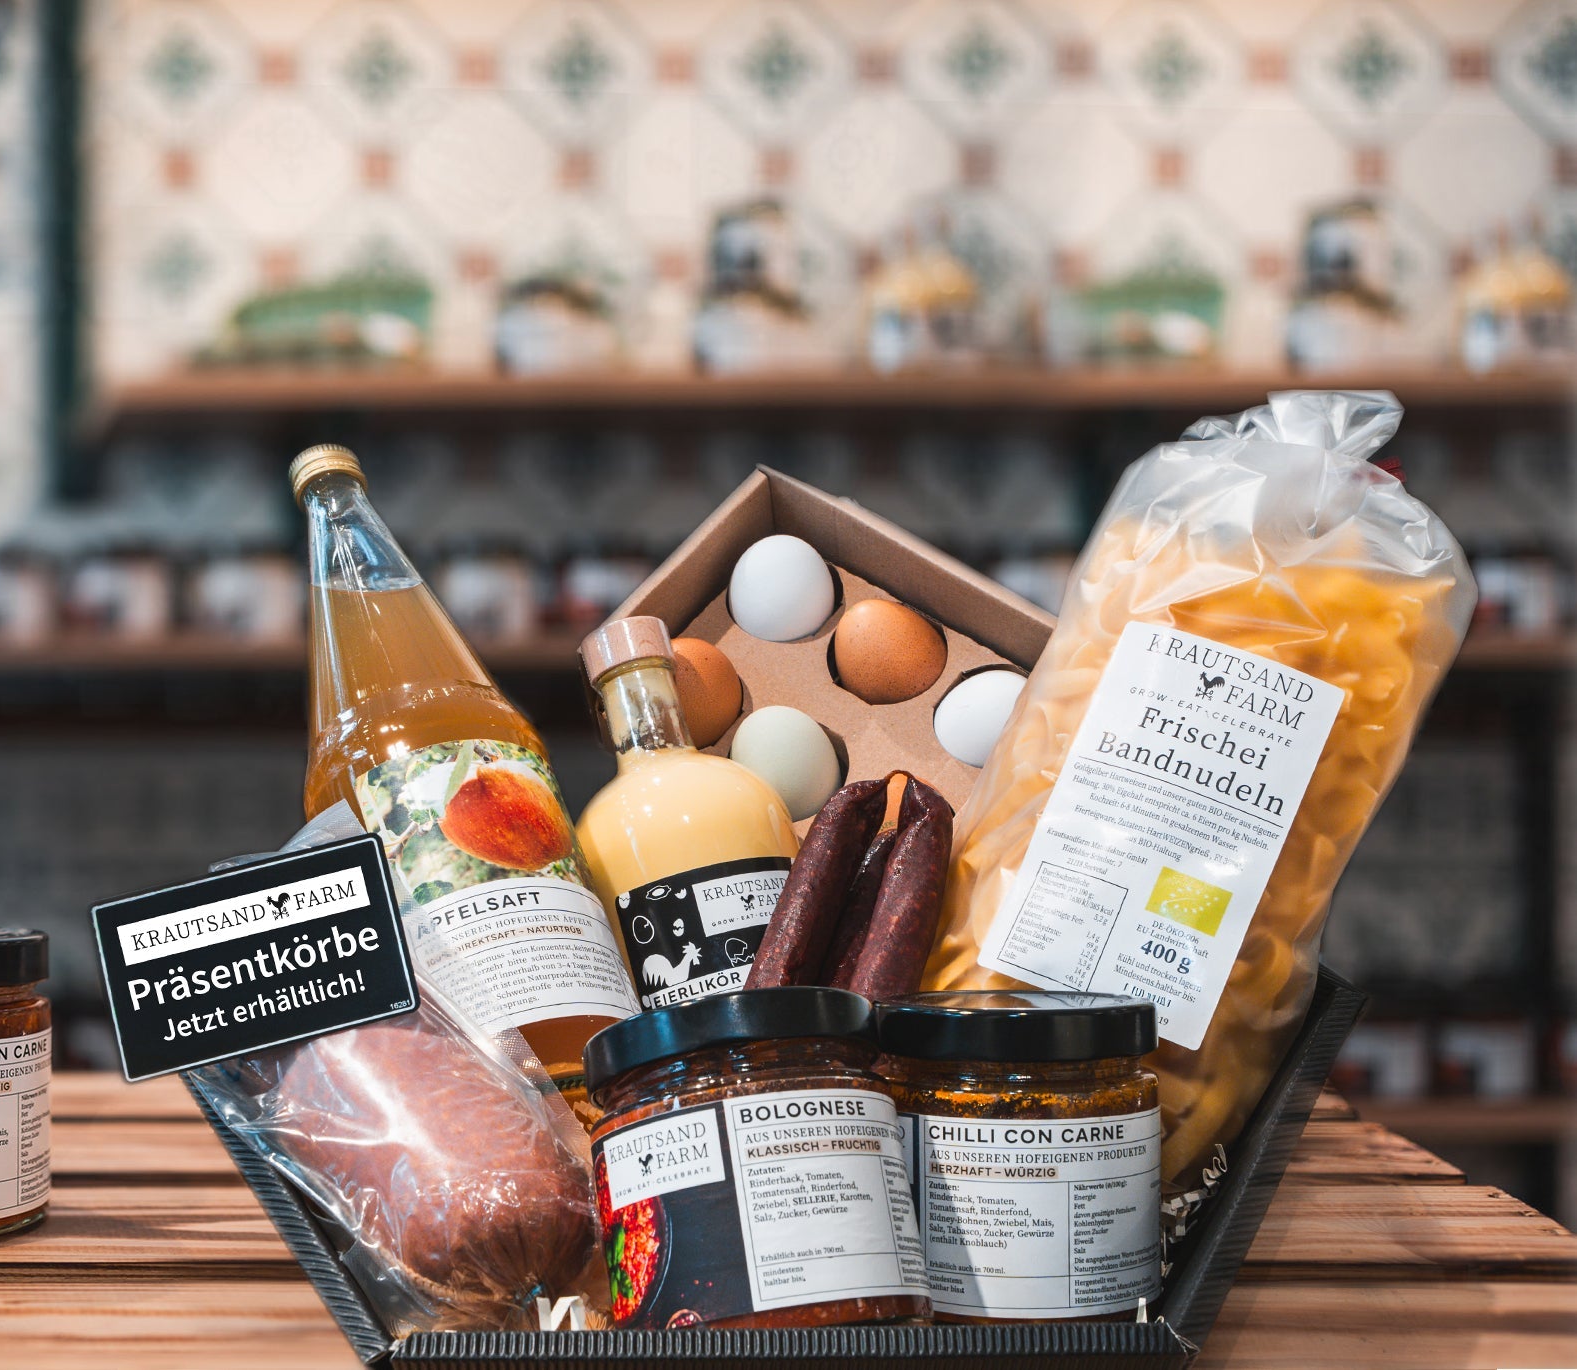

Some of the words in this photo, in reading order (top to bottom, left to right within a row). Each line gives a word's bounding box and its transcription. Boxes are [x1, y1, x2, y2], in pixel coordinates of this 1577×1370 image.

[1147, 634, 1313, 703] KRAUTSAND
[1223, 684, 1305, 730] FARM
[1177, 700, 1202, 713] EAT
[1212, 711, 1293, 748] CELEBRATE
[1139, 707, 1270, 771] Frischei
[1096, 731, 1284, 816] Bandnudeln
[1145, 795, 1180, 813] entspricht
[1241, 832, 1269, 850] Nudeln.
[1163, 788, 1186, 802] unsere
[1186, 797, 1207, 811] guten
[1208, 803, 1239, 824] BIO-Eier
[1252, 823, 1279, 840] eigener
[1169, 817, 1211, 840] gesalzenem
[1212, 836, 1238, 852] Wasser.
[131, 902, 267, 952] KRAUTSAND
[293, 880, 357, 911] FARM
[496, 914, 560, 927] HOFEIGENEN
[712, 917, 734, 927] GROW
[527, 926, 582, 935] NATURTRÜB
[1152, 921, 1200, 945] DE-ÖKO-006
[1141, 940, 1177, 963] 400
[1177, 958, 1193, 974] g
[127, 925, 380, 1011] Präsentkörbe
[1150, 966, 1177, 983] trocken
[496, 982, 552, 1000] Schwebstoffe
[653, 969, 741, 1008] EIERLIKÖR
[1155, 980, 1182, 996] haltbar
[163, 1006, 229, 1041] Jetzt
[233, 969, 366, 1023] erhältlich!
[14, 1038, 47, 1059] CARNE
[740, 1101, 866, 1123] BOLOGNESE
[608, 1122, 707, 1164] KRAUTSAND
[746, 1132, 769, 1144] AUS
[773, 1128, 832, 1141] UNSEREN
[835, 1125, 889, 1137] HOFEIGENEN
[929, 1125, 995, 1144] CHILLI
[1004, 1129, 1052, 1144] CON
[1061, 1125, 1124, 1142] CARNE
[656, 1143, 709, 1169] FARM
[747, 1142, 820, 1159] KLASSISCH
[831, 1140, 880, 1150] FRUCHTIG
[930, 1150, 950, 1160] AUS
[954, 1152, 1010, 1163] UNSEREN
[1015, 1151, 1093, 1164] HOFEIGENEN
[1097, 1144, 1146, 1160] PRODUKTEN
[657, 1166, 712, 1185] CELEBRATE
[747, 1166, 785, 1176] Zutaten:
[749, 1173, 804, 1188] Rinderhack,
[805, 1170, 844, 1181] Tomaten,
[931, 1163, 993, 1177] HERZHAFT
[1004, 1166, 1056, 1177] WÜRZIG
[929, 1181, 960, 1191] Zutaten:
[753, 1199, 791, 1211] Zwiebel,
[793, 1194, 838, 1206] SELLERIE,
[840, 1191, 873, 1202] Karotten,
[929, 1191, 975, 1204] Rinderhack,
[977, 1196, 1017, 1206] Tomaten,
[929, 1223, 946, 1234] Salz,
[948, 1226, 982, 1237] Tabasco,
[984, 1229, 1015, 1238] Zucker,
[1017, 1229, 1055, 1237] Gewürze
